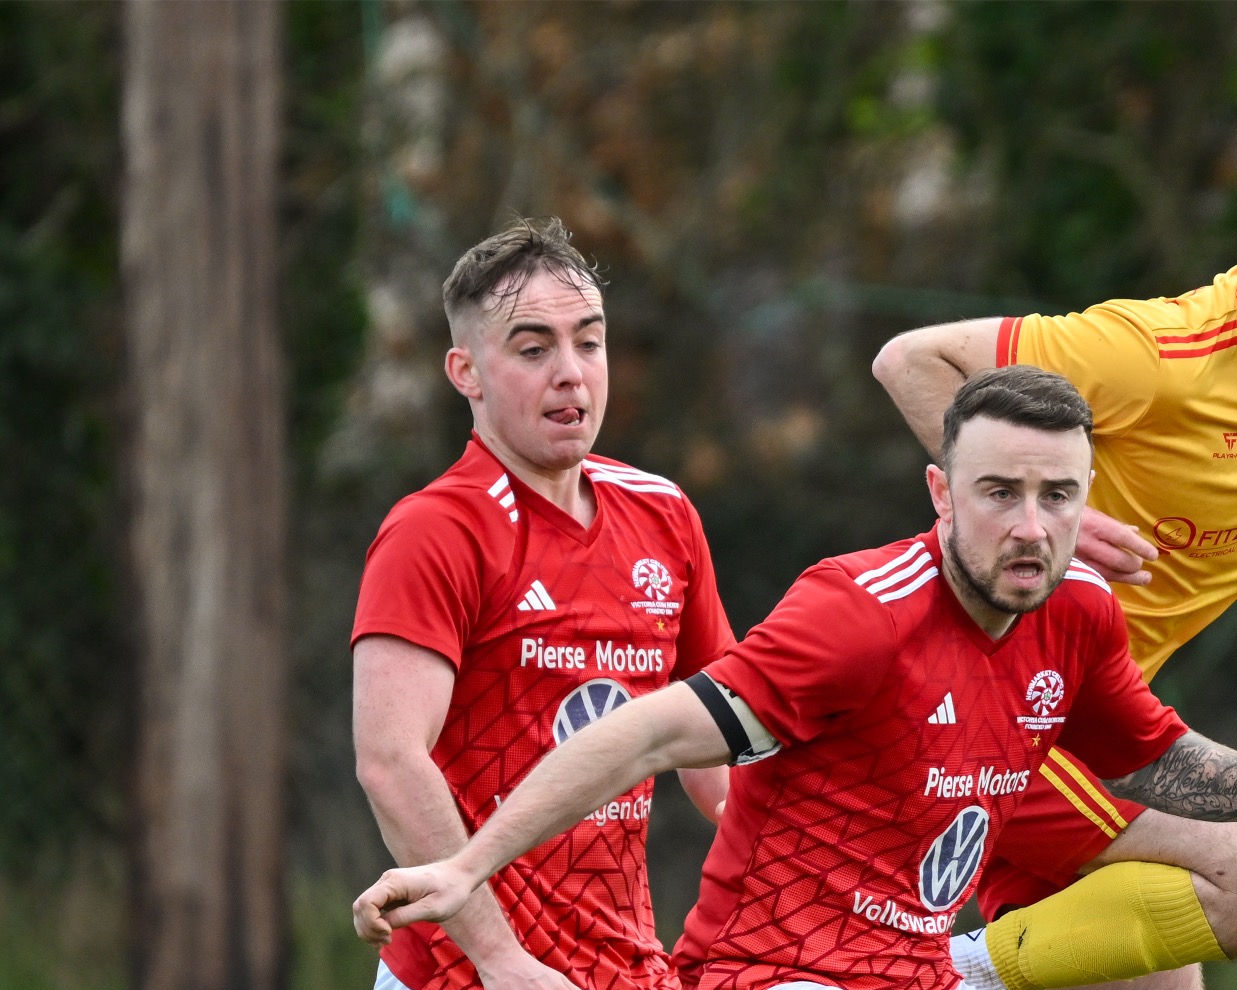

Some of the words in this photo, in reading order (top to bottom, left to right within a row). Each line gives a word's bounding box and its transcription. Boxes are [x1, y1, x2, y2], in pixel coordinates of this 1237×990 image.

[1189, 547, 1235, 558] ELECTRICAL
[520, 638, 586, 669] Pierse
[596, 640, 663, 672] Motors
[924, 767, 973, 798] Pierse
[977, 765, 1030, 796] Motors
